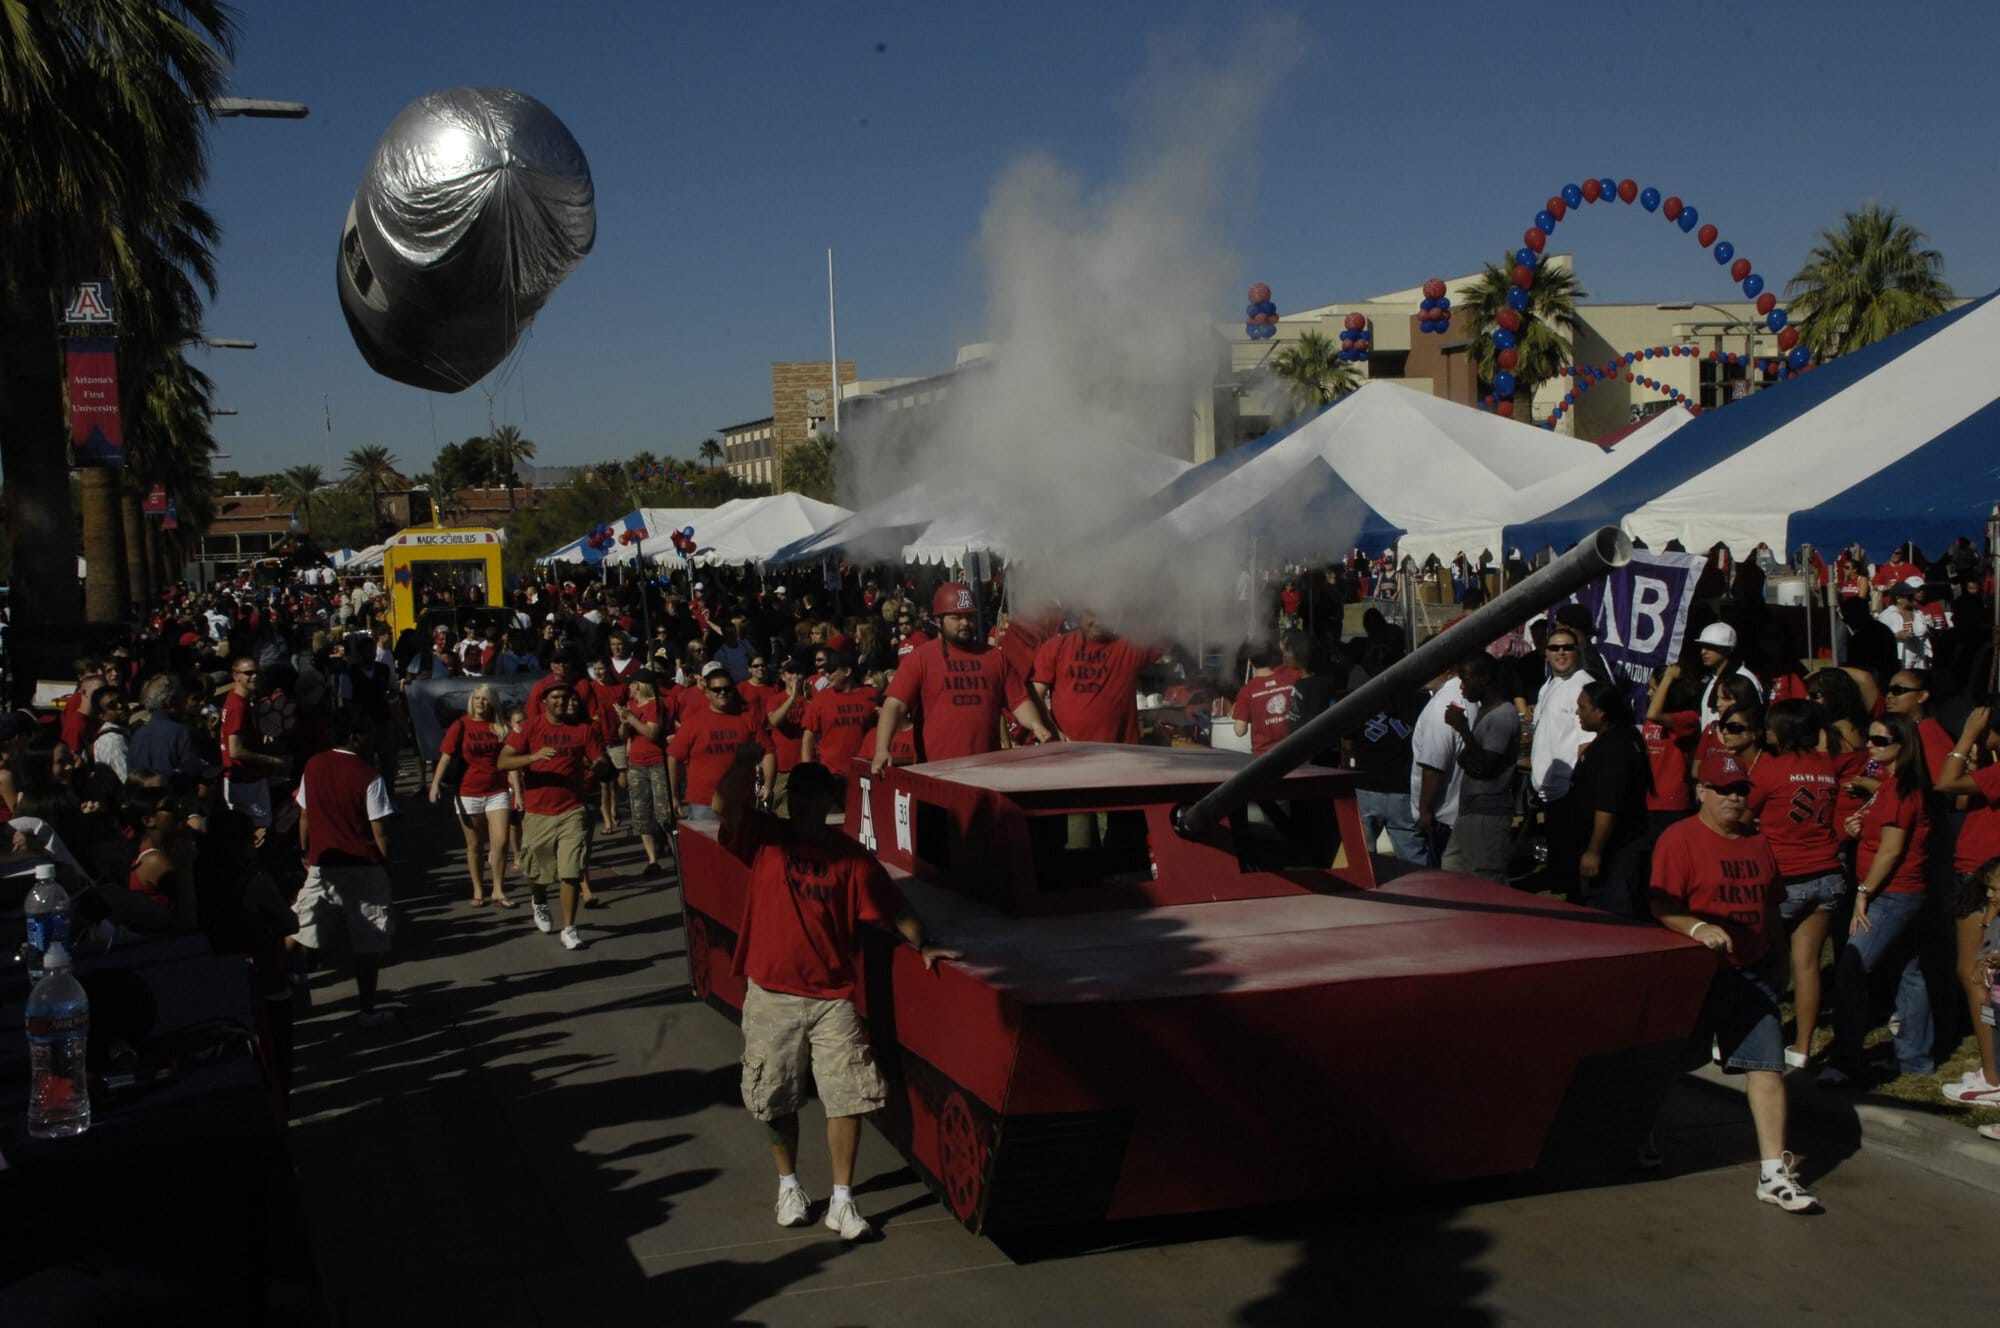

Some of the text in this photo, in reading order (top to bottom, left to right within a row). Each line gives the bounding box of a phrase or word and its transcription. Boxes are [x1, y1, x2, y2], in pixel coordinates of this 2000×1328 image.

[65, 282, 113, 323] A
[73, 376, 113, 384] Arizona's
[948, 660, 981, 672] RED
[944, 676, 988, 690] ARMY
[859, 777, 877, 852] A
[1720, 860, 1759, 878] RED
[1714, 884, 1767, 903] ARMY
